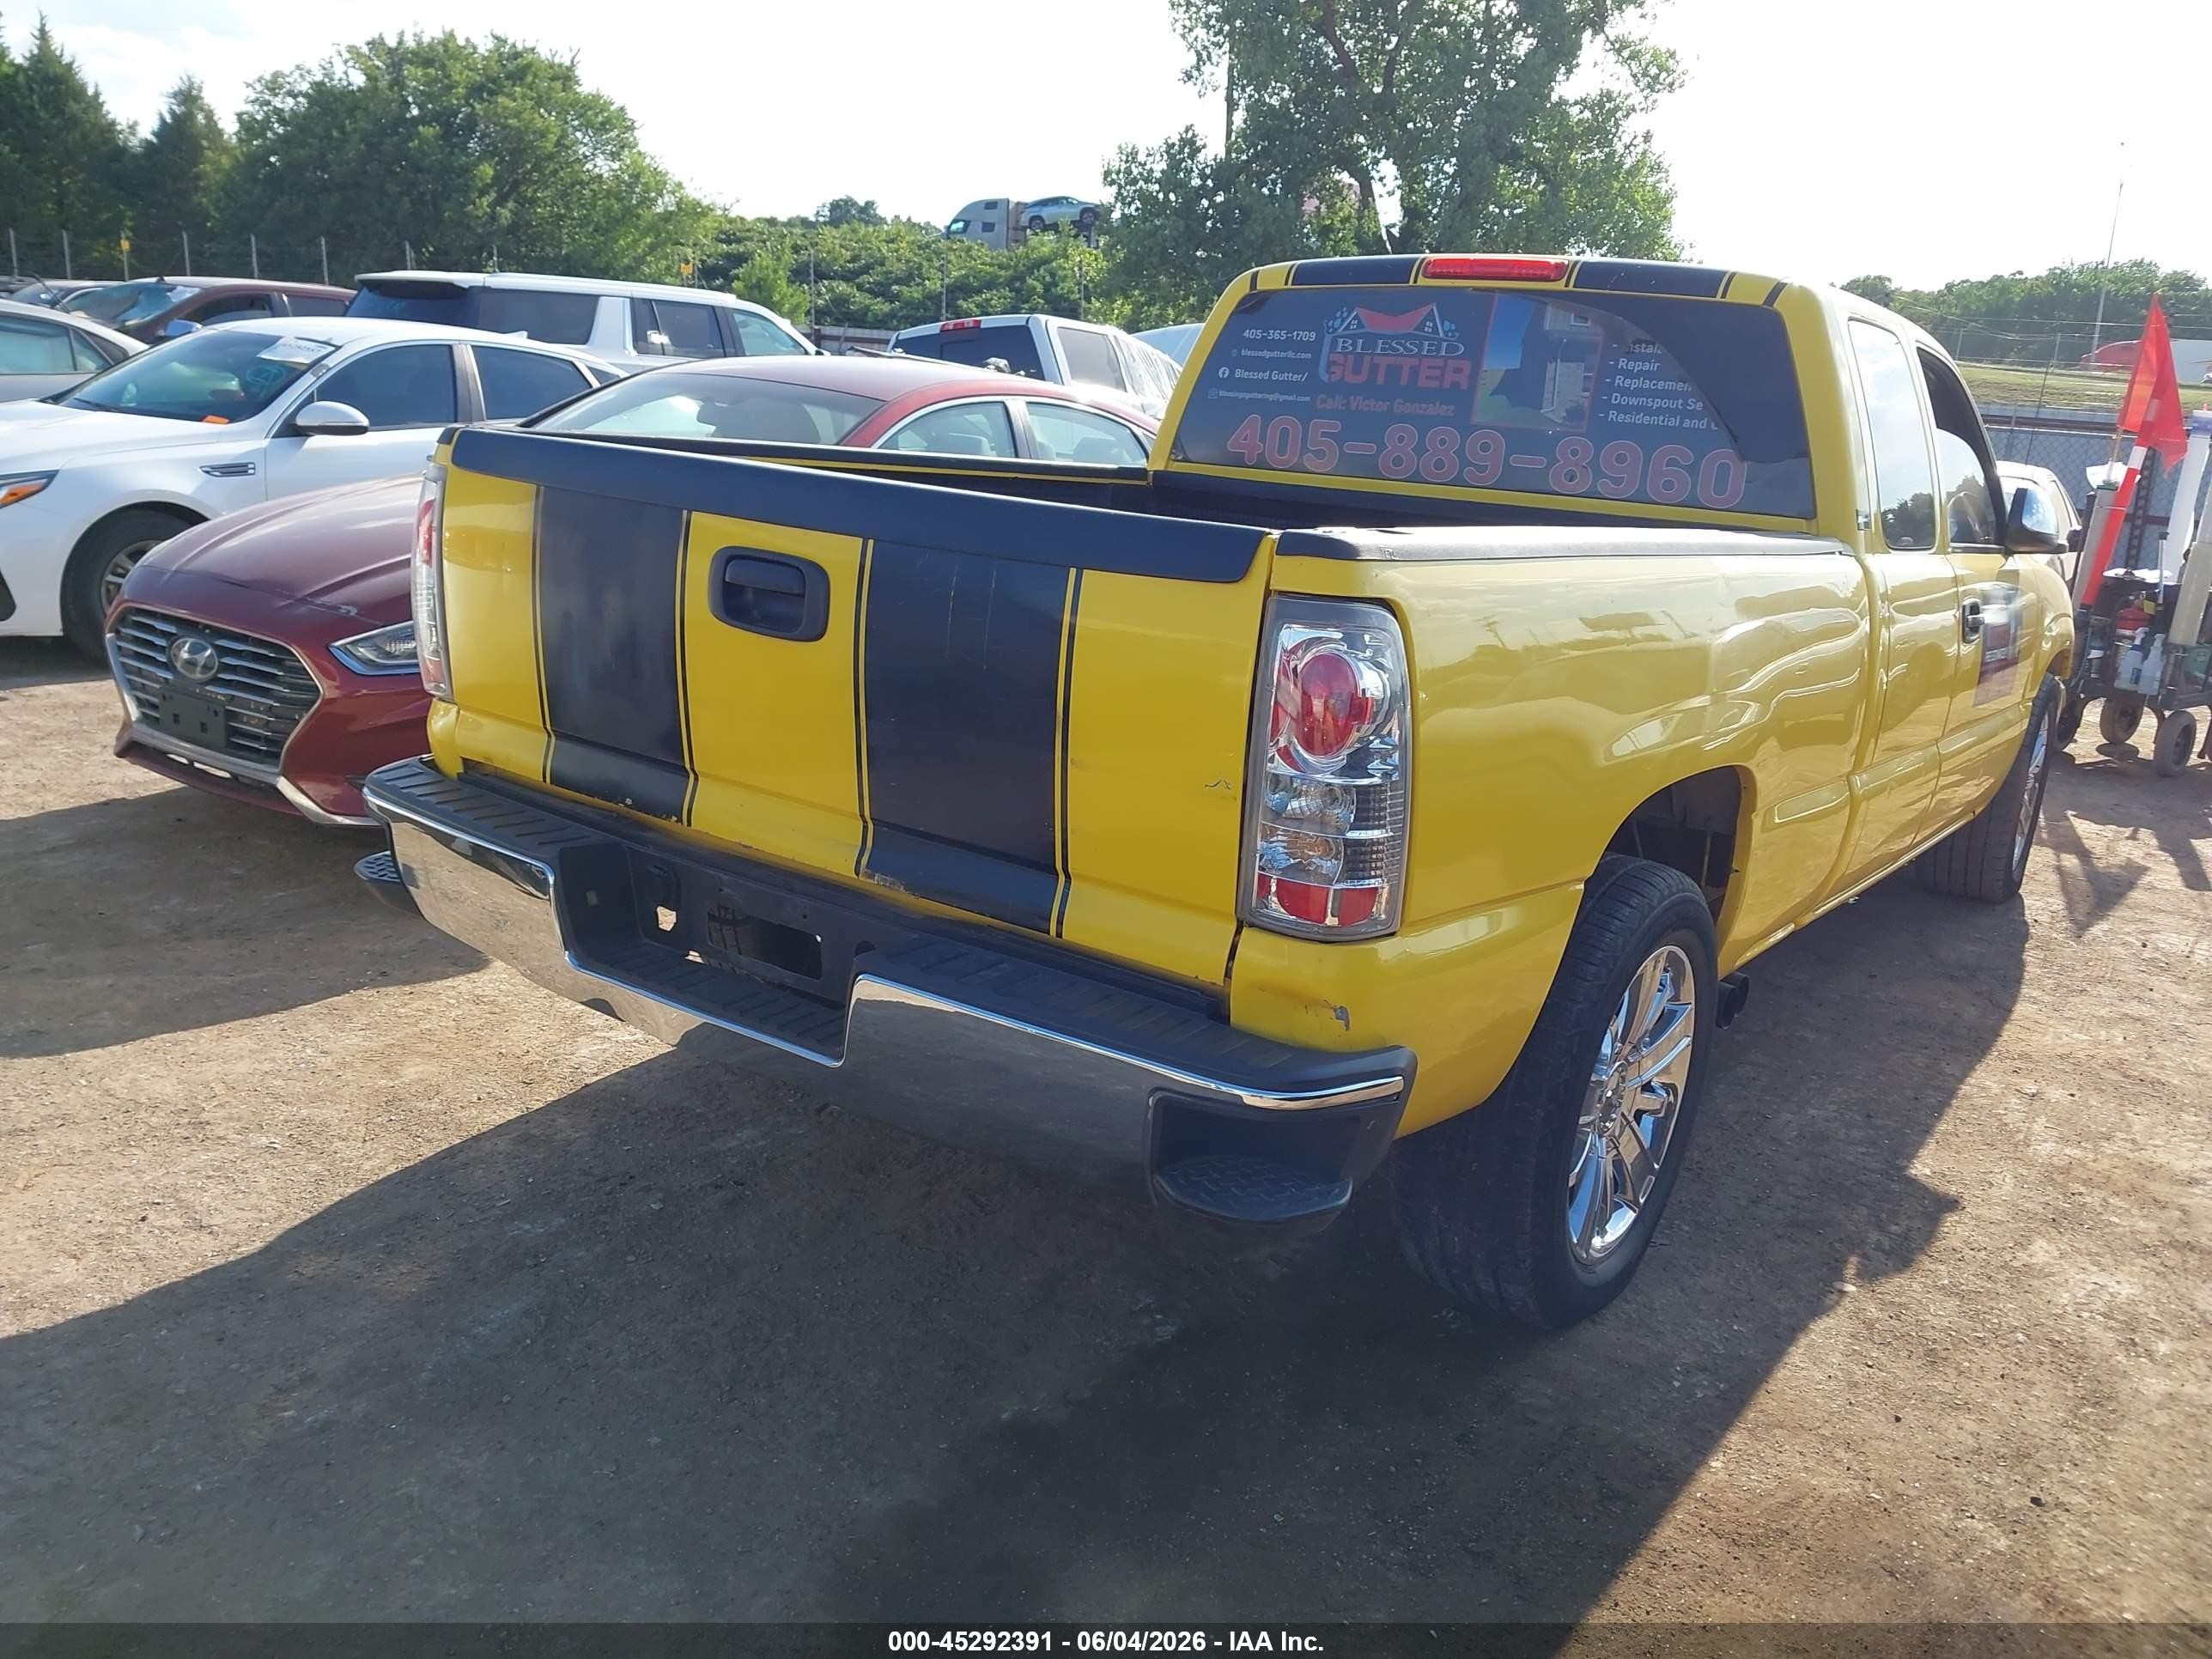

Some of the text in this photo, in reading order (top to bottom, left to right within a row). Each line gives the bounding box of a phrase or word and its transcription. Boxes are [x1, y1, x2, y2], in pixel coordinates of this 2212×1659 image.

[1243, 329, 1316, 342] 405-365-1709
[1334, 337, 1465, 356] BLESSED
[1234, 368, 1270, 380] Blessed
[1328, 352, 1471, 390] GUTTER
[1618, 358, 1662, 374] Repair
[1316, 392, 1455, 417] Call: Victor Gonzalez
[1611, 392, 1684, 410] Downspout
[1607, 410, 1680, 428] Residential
[1682, 417, 1708, 430] and
[1227, 413, 1748, 509] 405-889-8960
